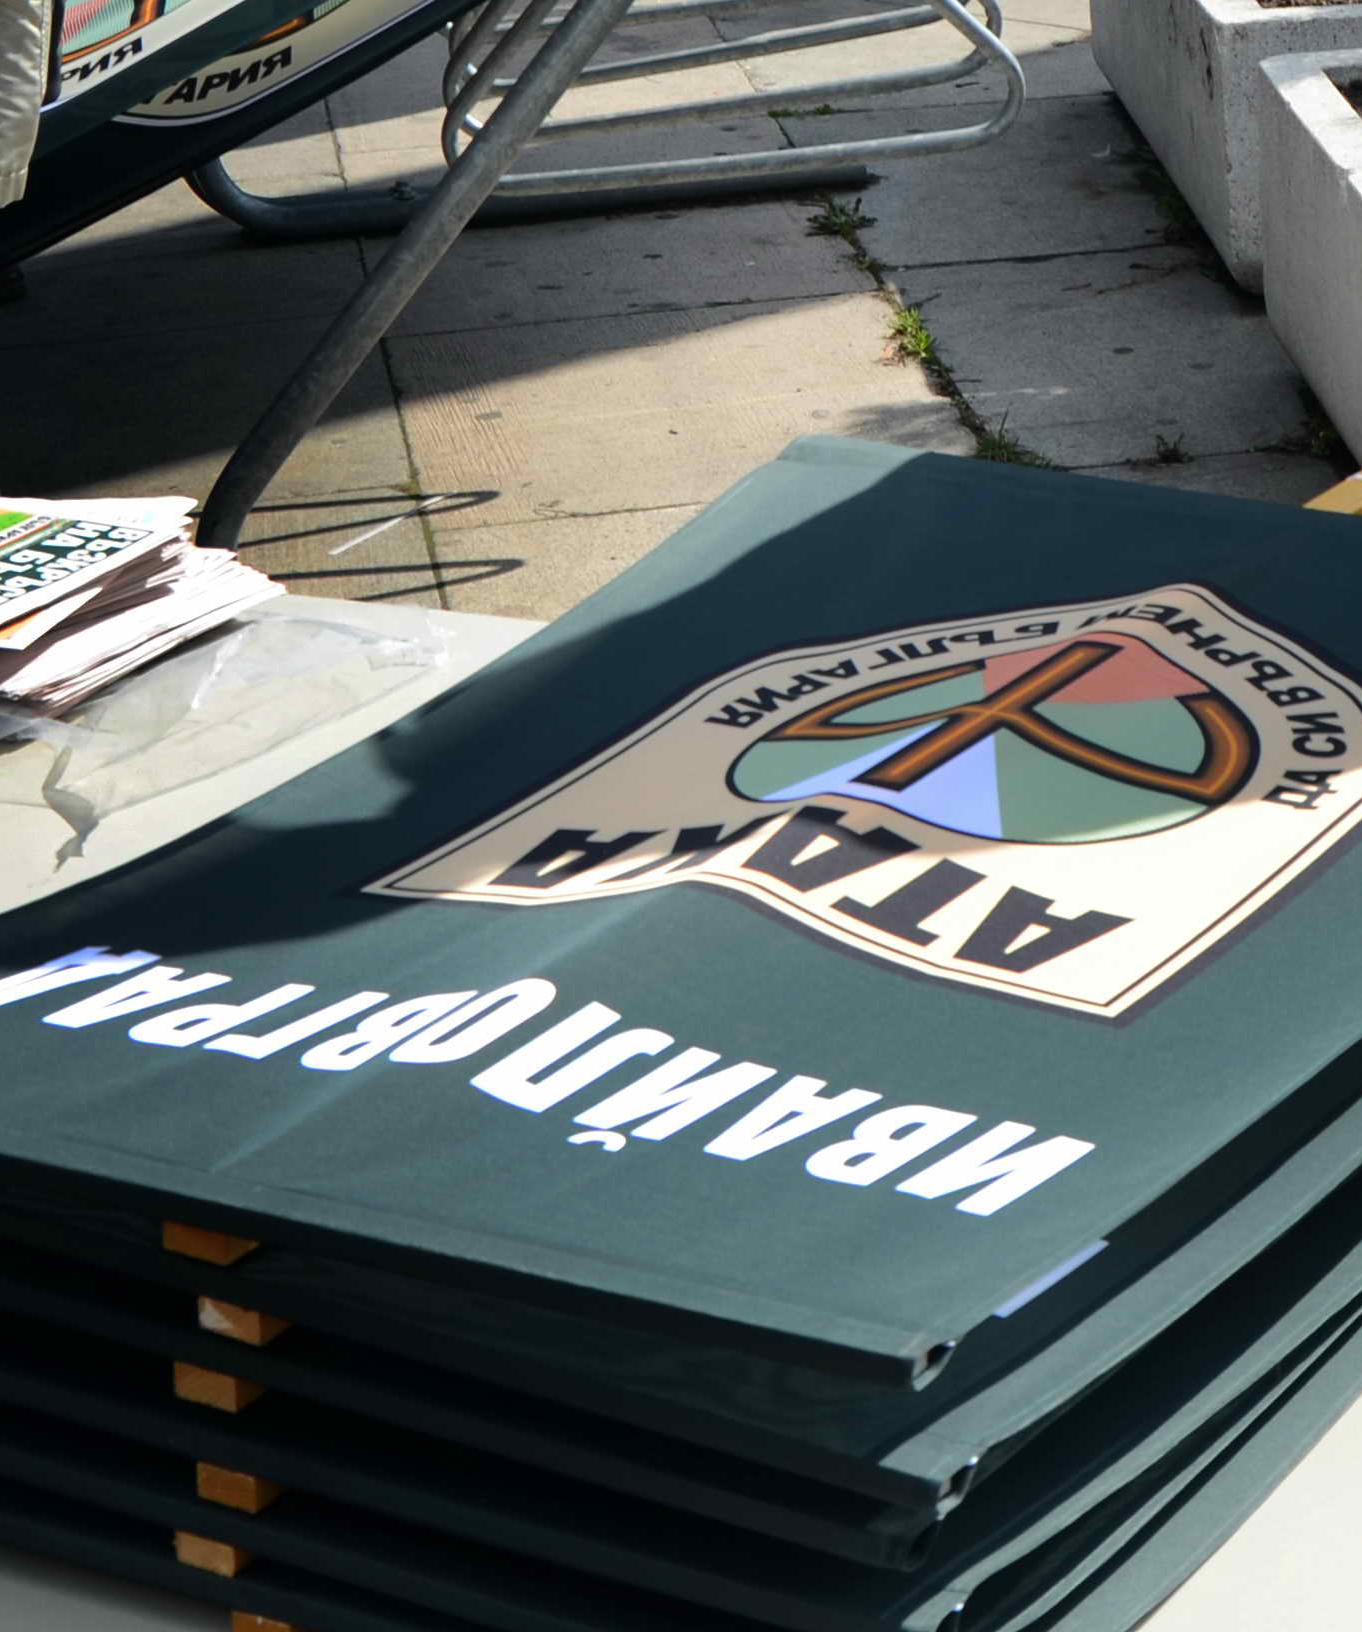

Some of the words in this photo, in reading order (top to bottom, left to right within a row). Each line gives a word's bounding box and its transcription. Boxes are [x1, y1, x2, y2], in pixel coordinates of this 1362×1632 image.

[41, 520, 115, 556] НА
[704, 621, 1061, 729] БЪЛГАРИЯ
[1288, 709, 1349, 761] СИ
[1263, 768, 1337, 812] ДА
[487, 805, 1136, 974] АТАКА
